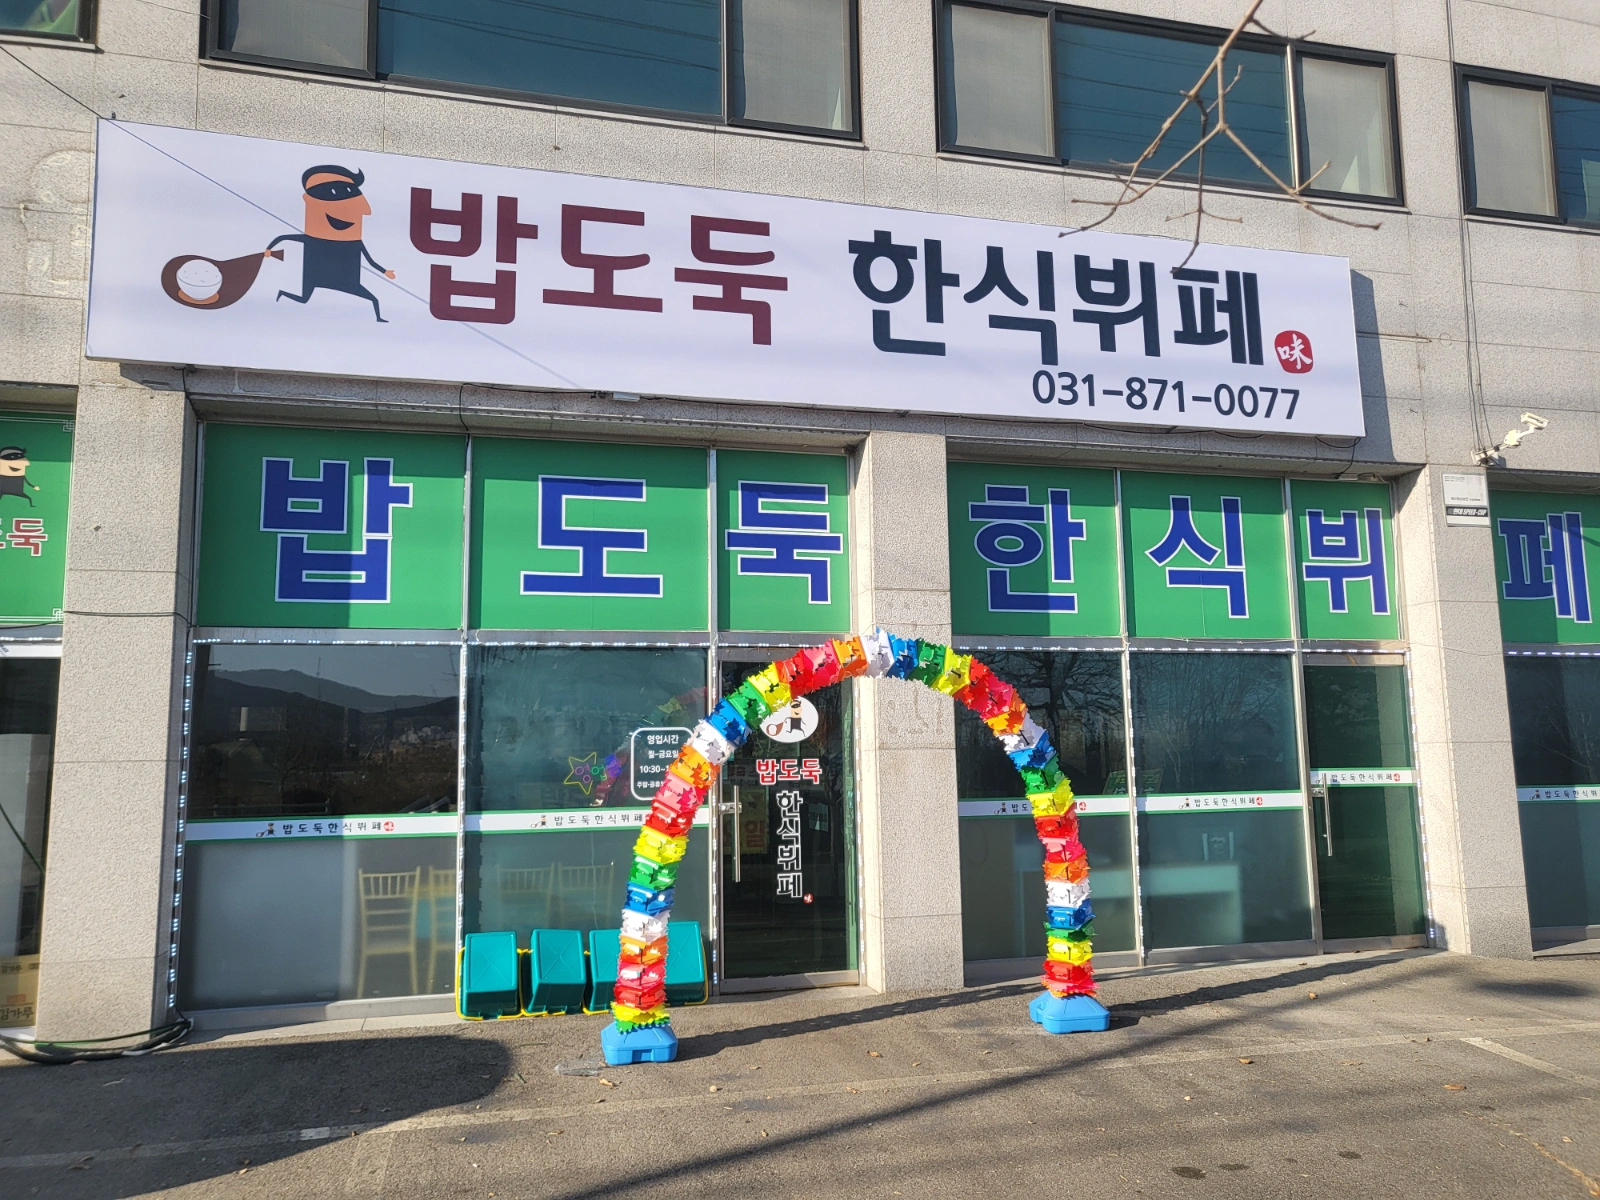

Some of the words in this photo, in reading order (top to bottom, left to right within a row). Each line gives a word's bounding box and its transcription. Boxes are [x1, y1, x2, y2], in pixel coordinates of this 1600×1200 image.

[410, 187, 788, 345] 밥도둑
[848, 229, 1264, 366] 한식뷔페
[1032, 369, 1300, 420] 031-871-0077
[0, 518, 48, 556] 둑
[647, 734, 679, 745] 영업시간
[756, 758, 823, 785] 밥도둑
[776, 790, 803, 898] 한식뷔페
